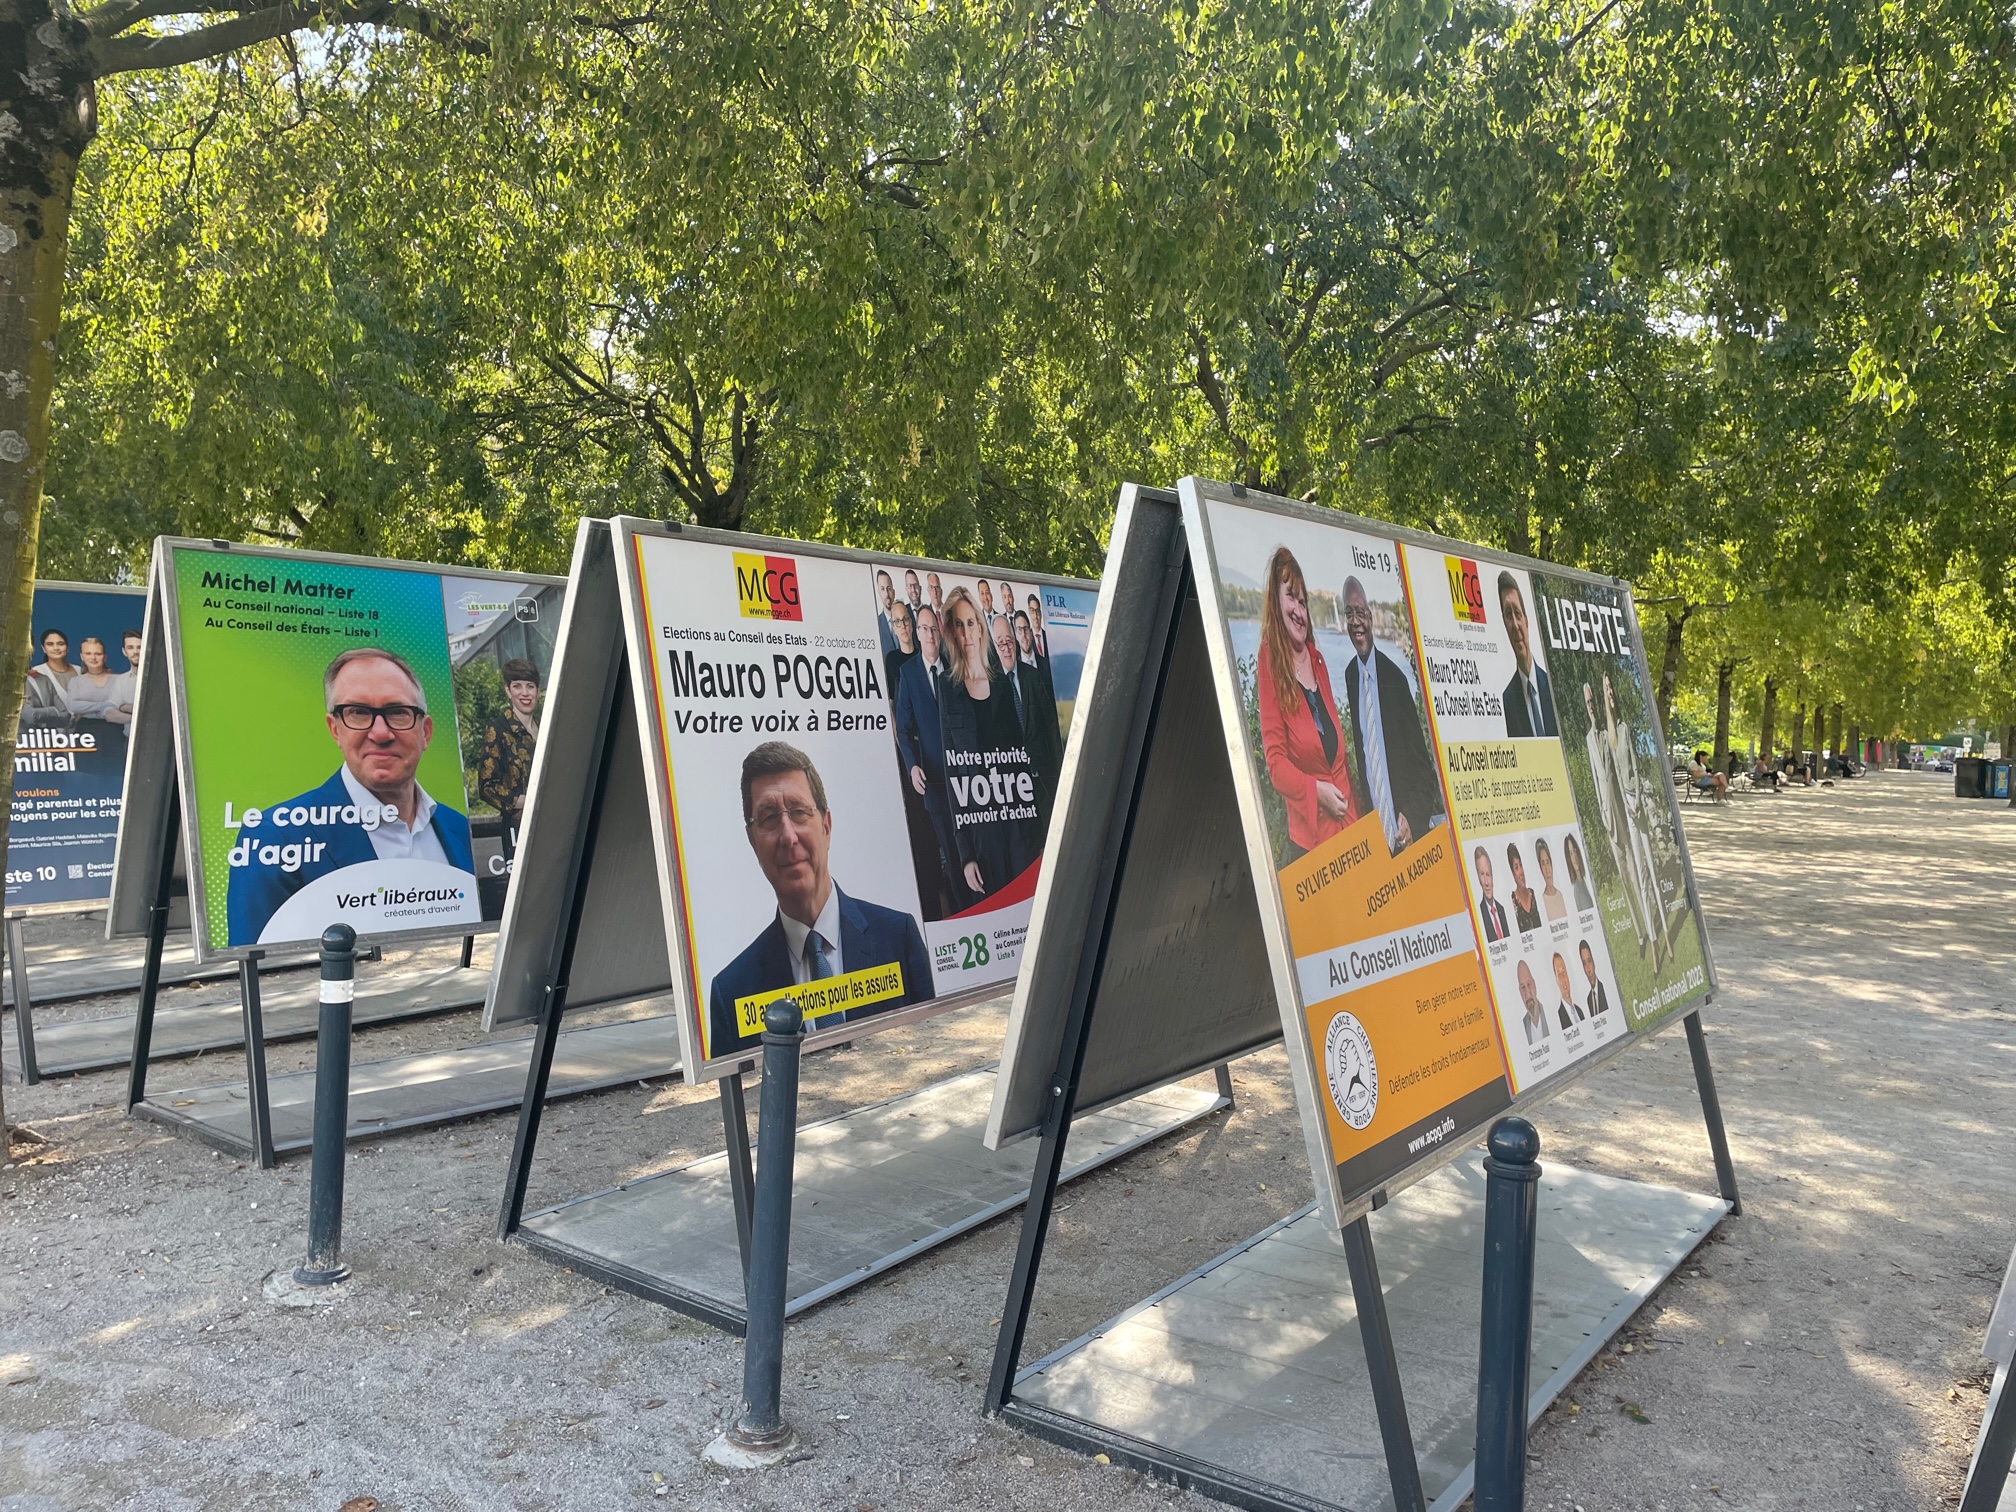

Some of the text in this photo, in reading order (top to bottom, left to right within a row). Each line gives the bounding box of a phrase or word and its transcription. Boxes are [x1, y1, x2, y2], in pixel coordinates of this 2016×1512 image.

[1351, 545, 1391, 573] liste 19
[201, 571, 355, 600] Michel Matter
[737, 567, 799, 606] MCG
[1447, 569, 1483, 608] MCG
[203, 597, 379, 620] Au Conseil national Liste 18
[518, 605, 529, 613] PS
[749, 607, 791, 619] www.mcge.ch
[1045, 594, 1067, 608] PLR
[205, 617, 378, 638] Au Conseil des États Liste 1
[663, 626, 876, 650] Elections au Conseil des Etats 22 octobre 2023
[1541, 594, 1631, 656] LIBERTÉ
[1423, 635, 1444, 648] Elections
[1466, 640, 1473, 651] 22
[668, 649, 883, 700] Mauro POGGIA
[1426, 656, 1481, 685] Mauro POGGIA
[1434, 690, 1502, 717] au Conseil des Etats
[674, 709, 888, 734] Votre voix à Berne
[945, 746, 1031, 769] Notre priorité,
[1448, 744, 1518, 772] Au Conseil national
[15, 788, 59, 797] voulons
[949, 766, 1035, 807] votre
[1453, 773, 1554, 801] la liste MCG des opposants à la hausse
[36, 798, 82, 810] parental
[85, 798, 97, 807] et
[100, 797, 122, 808] plus
[51, 810, 77, 821] pour
[80, 809, 96, 818] les
[224, 801, 400, 832] Le courage
[955, 803, 1038, 830] pouvoir d'achat
[1460, 810, 1472, 830] des
[1471, 808, 1491, 834] primes
[227, 836, 327, 873] d'agir
[36, 866, 56, 881] 10
[1296, 839, 1372, 903] SYLVIE RUFFIEUX
[1366, 843, 1443, 918] JOSEPH M. KABONGO
[1660, 877, 1674, 893] Chloé
[384, 903, 461, 918] créateurs d'avenir
[1606, 892, 1625, 911] Gérard
[993, 929, 1011, 939] Céline
[1003, 936, 1022, 948] Conseil
[934, 943, 957, 957] LISTE
[936, 956, 955, 965] CONSEIL
[958, 933, 990, 970] 28
[997, 951, 1010, 960] Liste
[1329, 923, 1453, 988] Au Conseil National
[937, 963, 960, 972] NATIONAL
[828, 983, 849, 1011] pour
[850, 977, 865, 999] les
[866, 968, 899, 996] assurés
[1416, 981, 1478, 1014] Bien gérer notre terre
[1633, 964, 1704, 1021] Conseil national 2023
[743, 1002, 757, 1026] 30
[1439, 1007, 1485, 1037] Servir la famille
[1326, 1015, 1351, 1053] ALLIANCE
[1354, 1109, 1371, 1126] POUR
[1388, 1037, 1491, 1095] Défendre les droits fondamentaux
[1408, 1116, 1455, 1154] www.acpg.info
